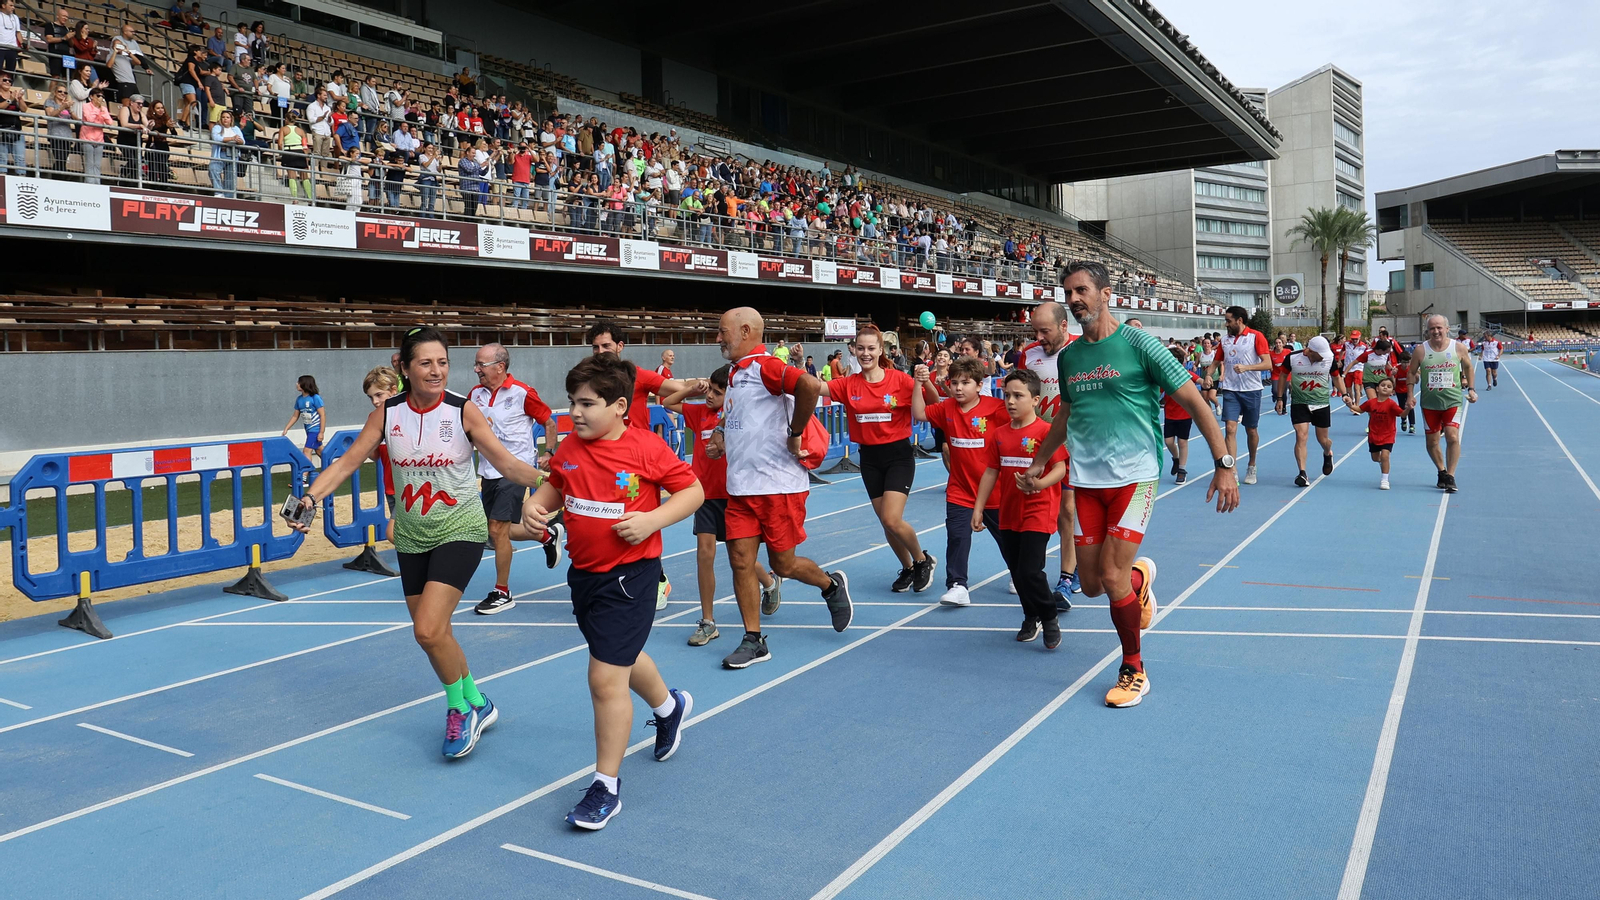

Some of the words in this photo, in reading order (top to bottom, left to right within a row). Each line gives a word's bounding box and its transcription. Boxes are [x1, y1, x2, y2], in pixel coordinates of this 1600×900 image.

[43, 196, 101, 209] Ayuntamiento
[56, 206, 77, 214] Jerez
[122, 200, 189, 221] PLAY
[178, 200, 260, 232] JEREZ
[310, 221, 350, 230] Ayuntamiento
[364, 223, 411, 240] PLAY
[402, 222, 461, 249] JEREZ
[496, 237, 525, 245] Ayuntamiento
[535, 238, 569, 253] PLAY
[663, 251, 689, 264] PLAY
[761, 261, 782, 272] PLAY
[1275, 285, 1299, 296] B&B
[391, 453, 454, 468] maratón
[574, 502, 600, 513] Navarro
[601, 506, 623, 514] Hnos.
